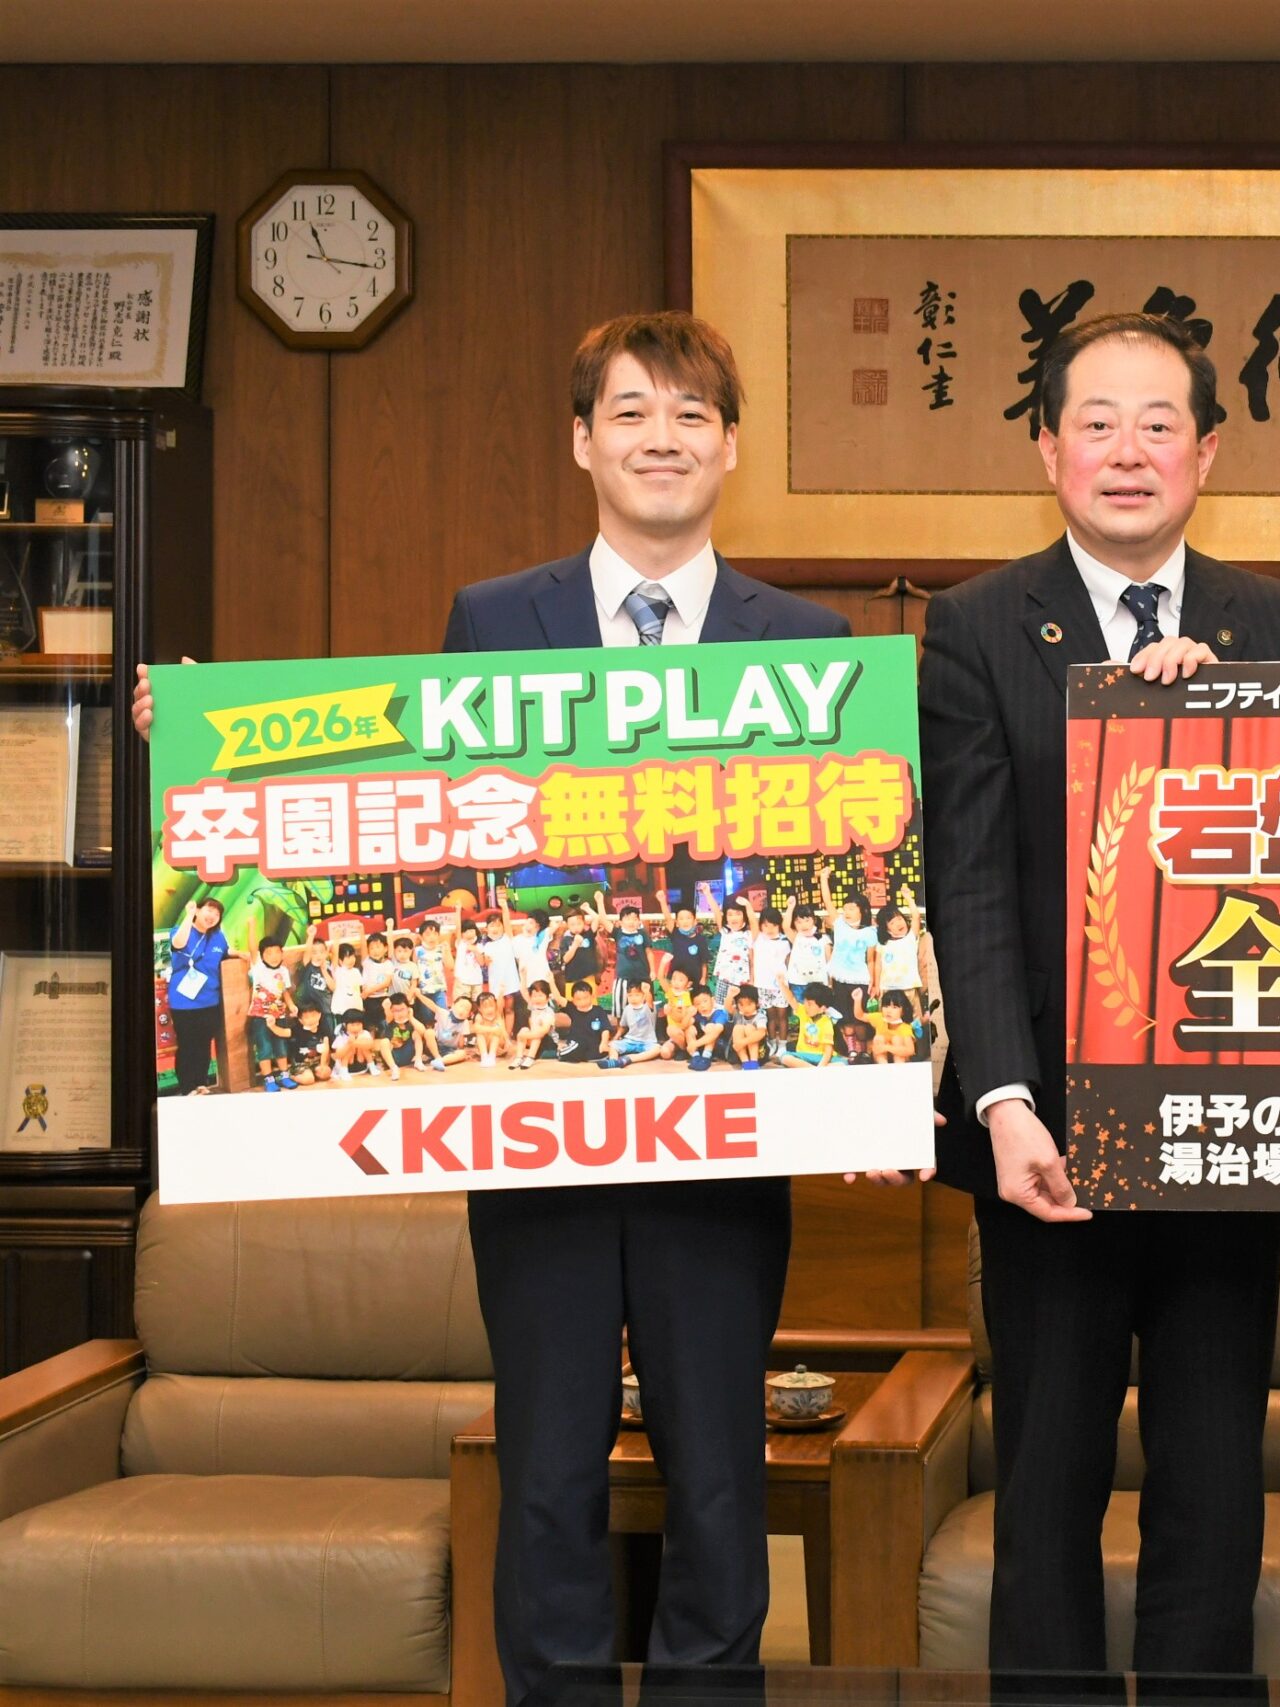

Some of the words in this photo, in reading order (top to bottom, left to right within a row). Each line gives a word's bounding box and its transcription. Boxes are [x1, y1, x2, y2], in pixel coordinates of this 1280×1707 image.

[292, 200, 306, 221] 11
[316, 193, 336, 216] 12
[350, 200, 357, 221] 1
[271, 221, 289, 242] 10
[366, 219, 380, 242] 2
[264, 247, 278, 270] 9
[374, 247, 386, 270] 3
[272, 274, 285, 298] 8
[366, 276, 379, 298] 4
[132, 289, 153, 342] 感謝状
[293, 296, 305, 318] 7
[319, 302, 332, 325] 6
[346, 296, 359, 318] 5
[421, 670, 596, 751] KIT
[606, 661, 860, 743] PLAY
[230, 703, 381, 758] 2026年
[169, 757, 905, 874] 卒園記念無料招待
[400, 1092, 759, 1175] KISUKE
